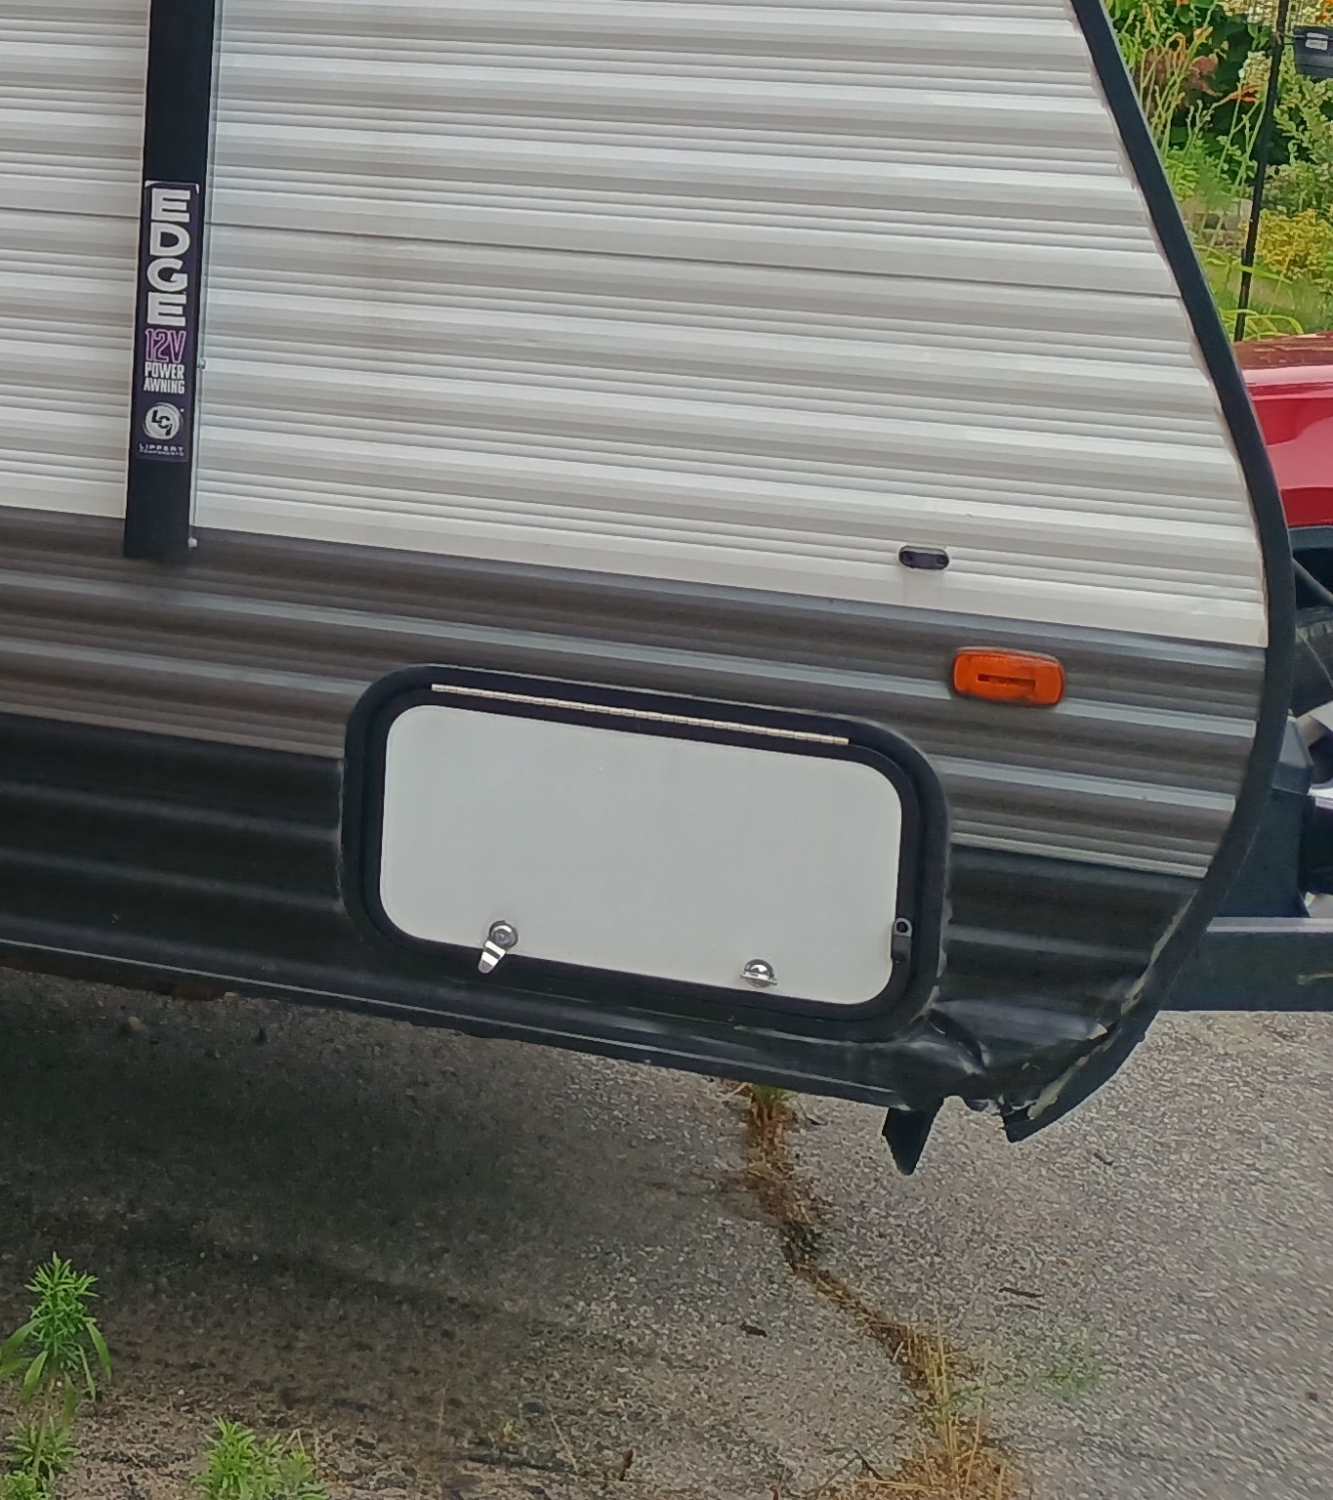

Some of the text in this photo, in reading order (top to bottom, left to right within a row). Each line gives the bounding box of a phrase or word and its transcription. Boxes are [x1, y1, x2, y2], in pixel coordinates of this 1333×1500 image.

[146, 187, 191, 327] EDGE
[145, 328, 187, 364] 12V
[144, 361, 185, 380] POWER
[143, 377, 185, 394] AWNING
